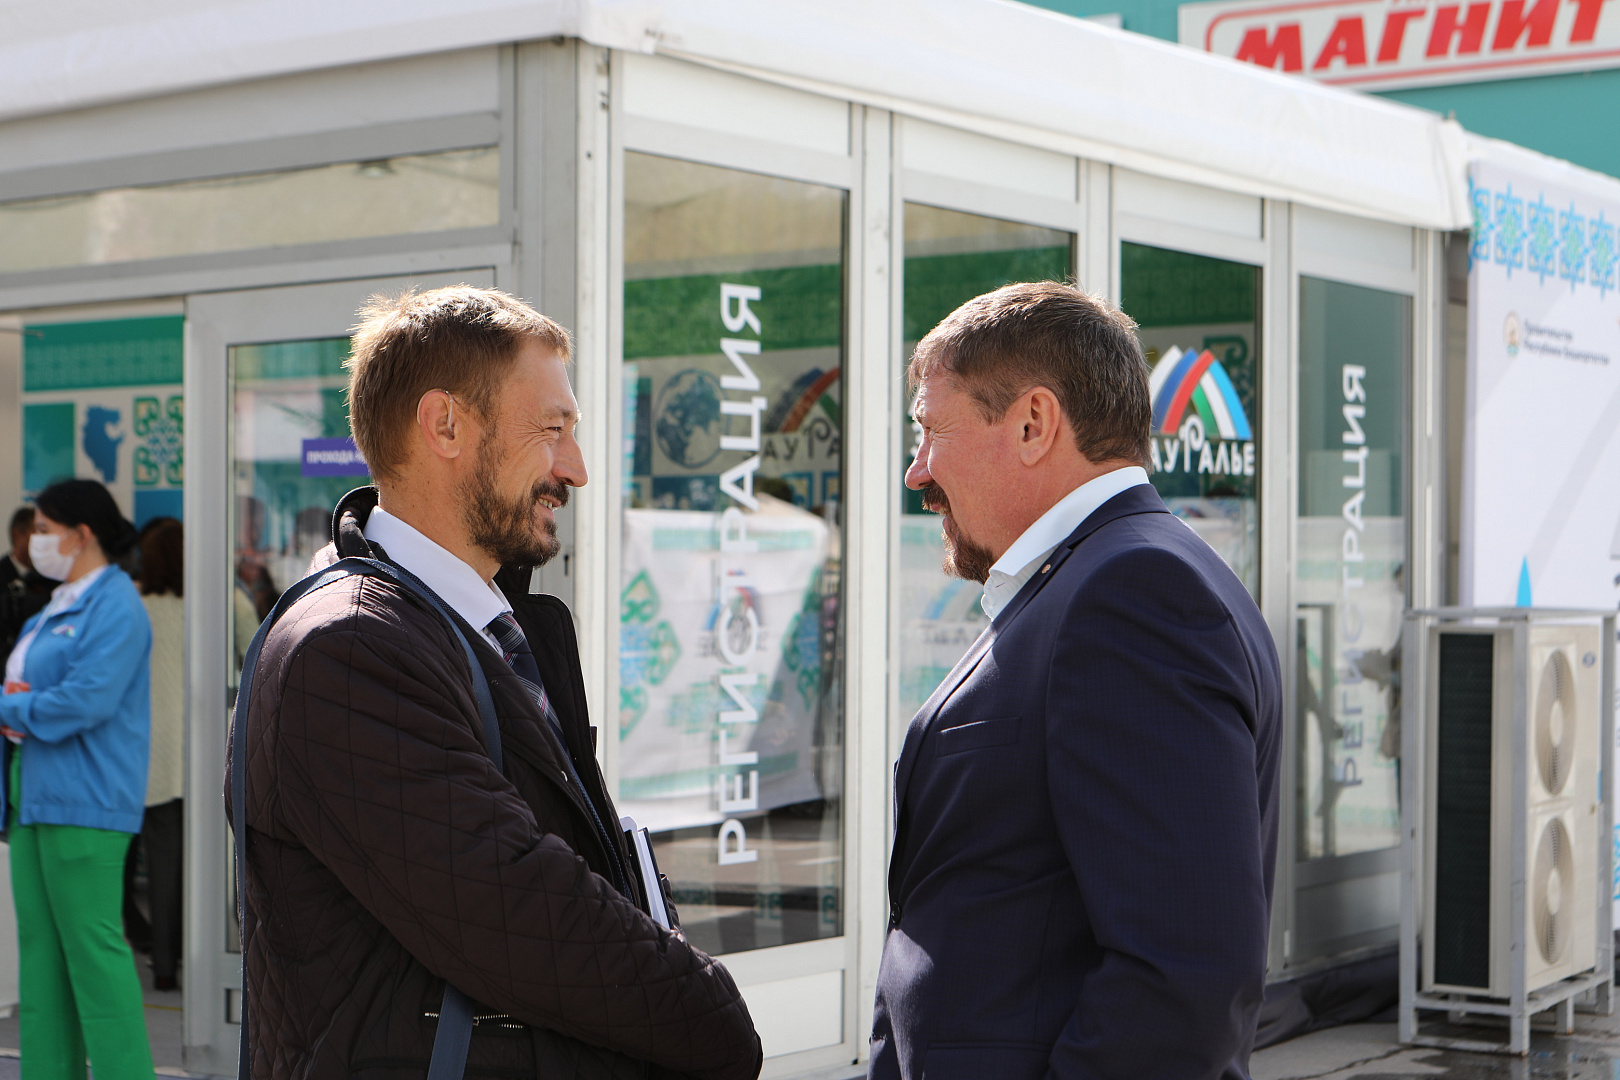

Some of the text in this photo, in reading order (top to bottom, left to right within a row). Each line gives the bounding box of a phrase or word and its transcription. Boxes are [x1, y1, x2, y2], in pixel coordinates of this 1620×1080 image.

[1234, 0, 1613, 72] МАГНИТ
[718, 282, 768, 866] РЕГИСТРАЦИЯ
[1341, 363, 1369, 788] РЕГИСТРАЦИЯ
